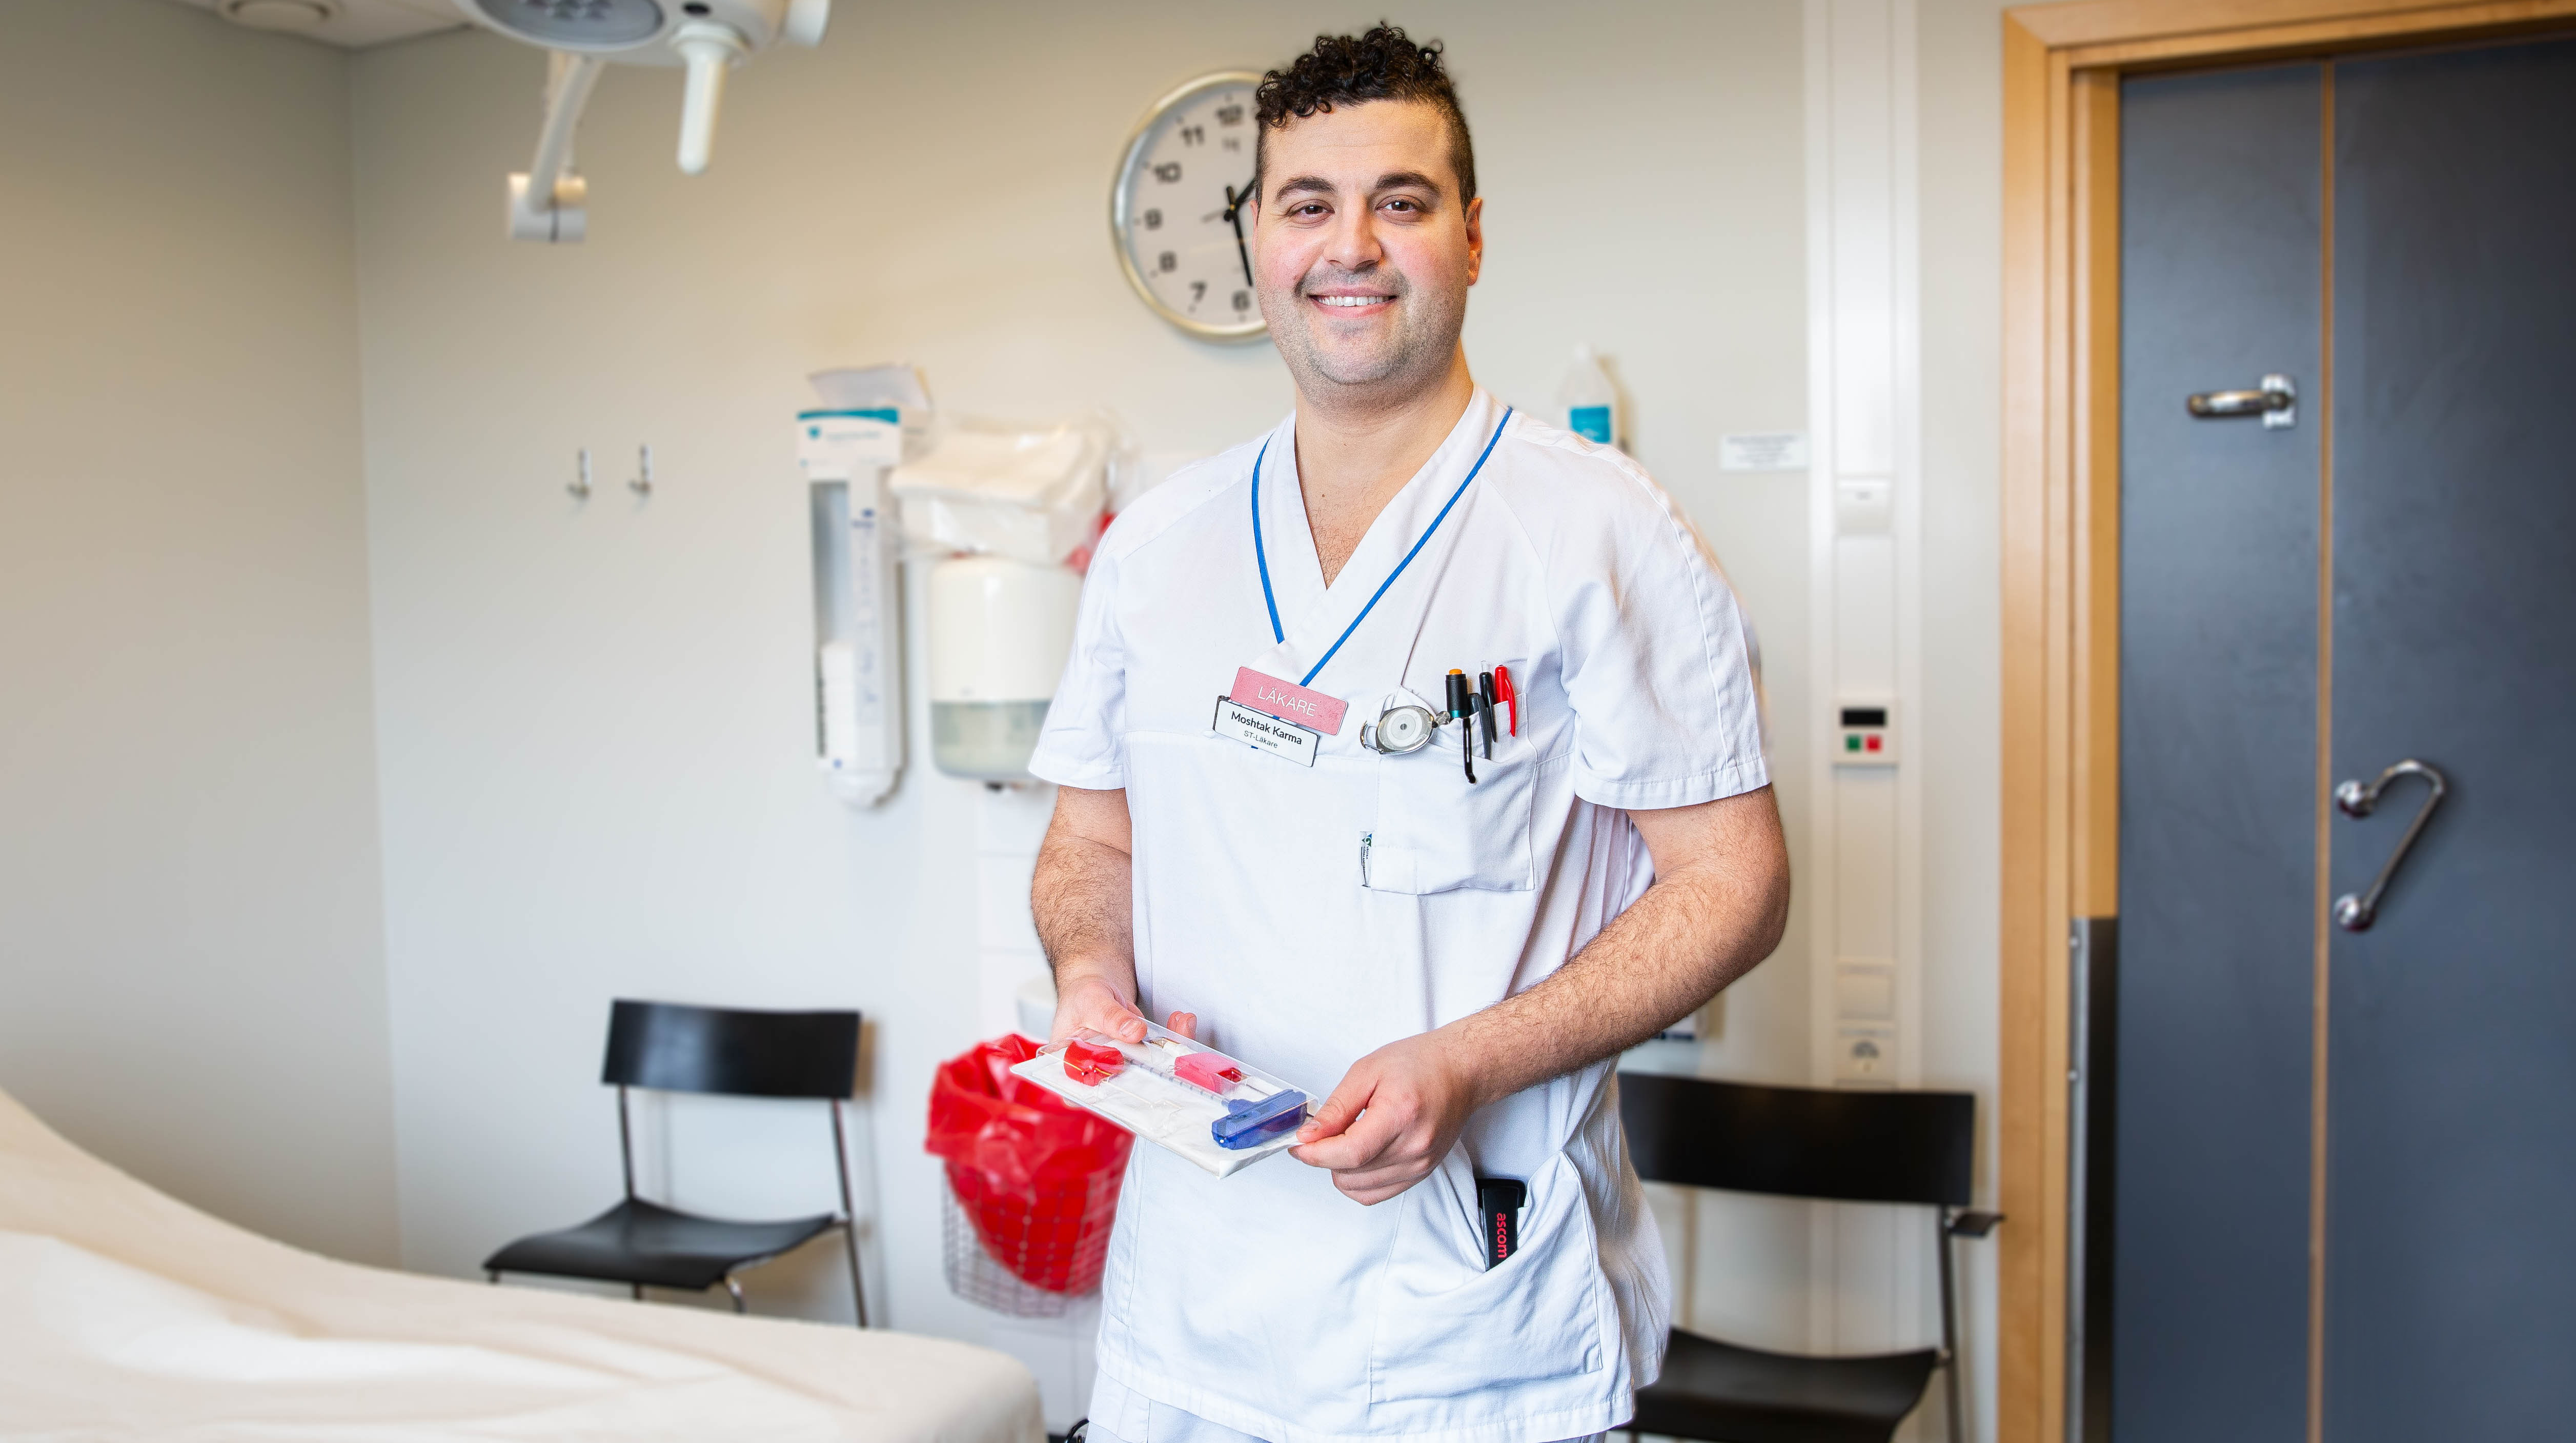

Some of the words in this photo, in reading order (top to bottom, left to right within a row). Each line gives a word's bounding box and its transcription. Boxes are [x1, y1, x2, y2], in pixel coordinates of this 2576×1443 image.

[1181, 126, 1204, 146] 11
[1154, 162, 1182, 184] 10
[1144, 209, 1163, 230] 9
[1159, 251, 1177, 273] 8
[1189, 281, 1207, 303] 7
[1232, 290, 1251, 312] 6
[1257, 686, 1318, 717] LÄKARE
[1231, 711, 1271, 733] Moshtak
[1272, 726, 1302, 745] Karma
[1244, 730, 1278, 749] ST-Läkare
[1496, 1213, 1508, 1258] ascom
